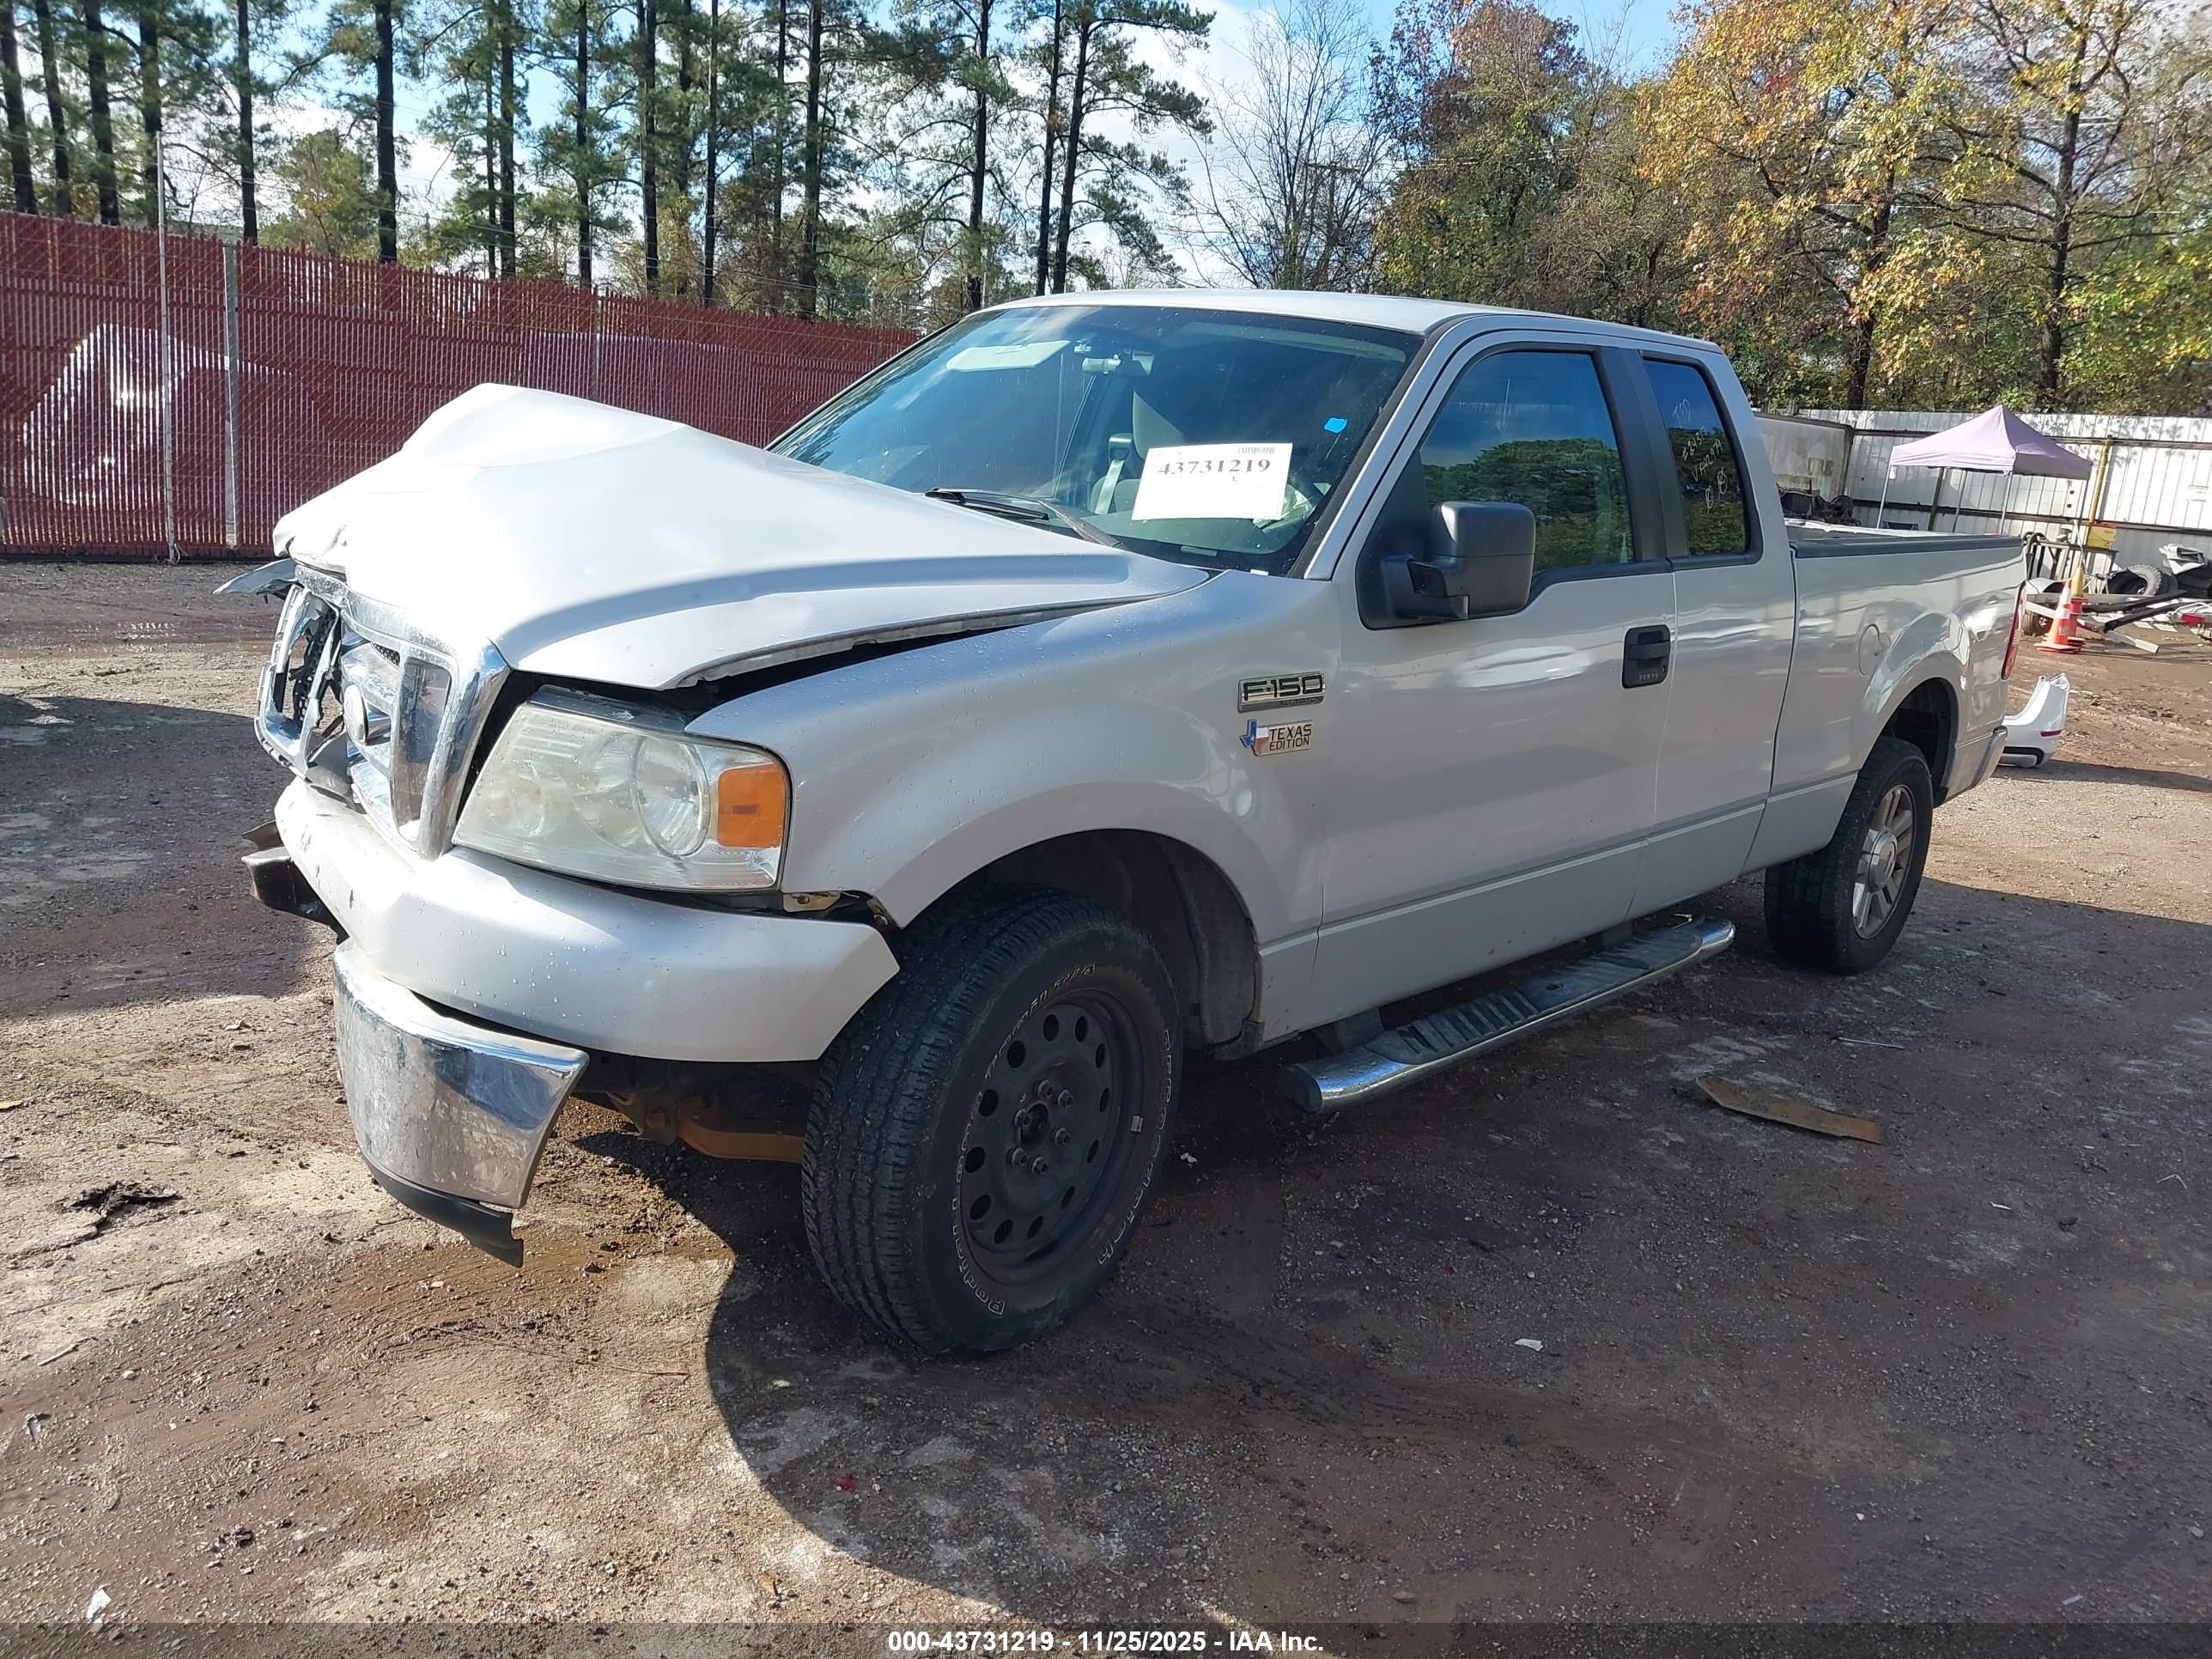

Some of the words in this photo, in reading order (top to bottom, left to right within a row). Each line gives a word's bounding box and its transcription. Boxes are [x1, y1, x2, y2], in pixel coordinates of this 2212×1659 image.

[1158, 458, 1271, 475] 43731219
[1243, 674, 1323, 701] F-150
[1269, 724, 1312, 741] TEXAS
[1269, 736, 1310, 750] EDITION
